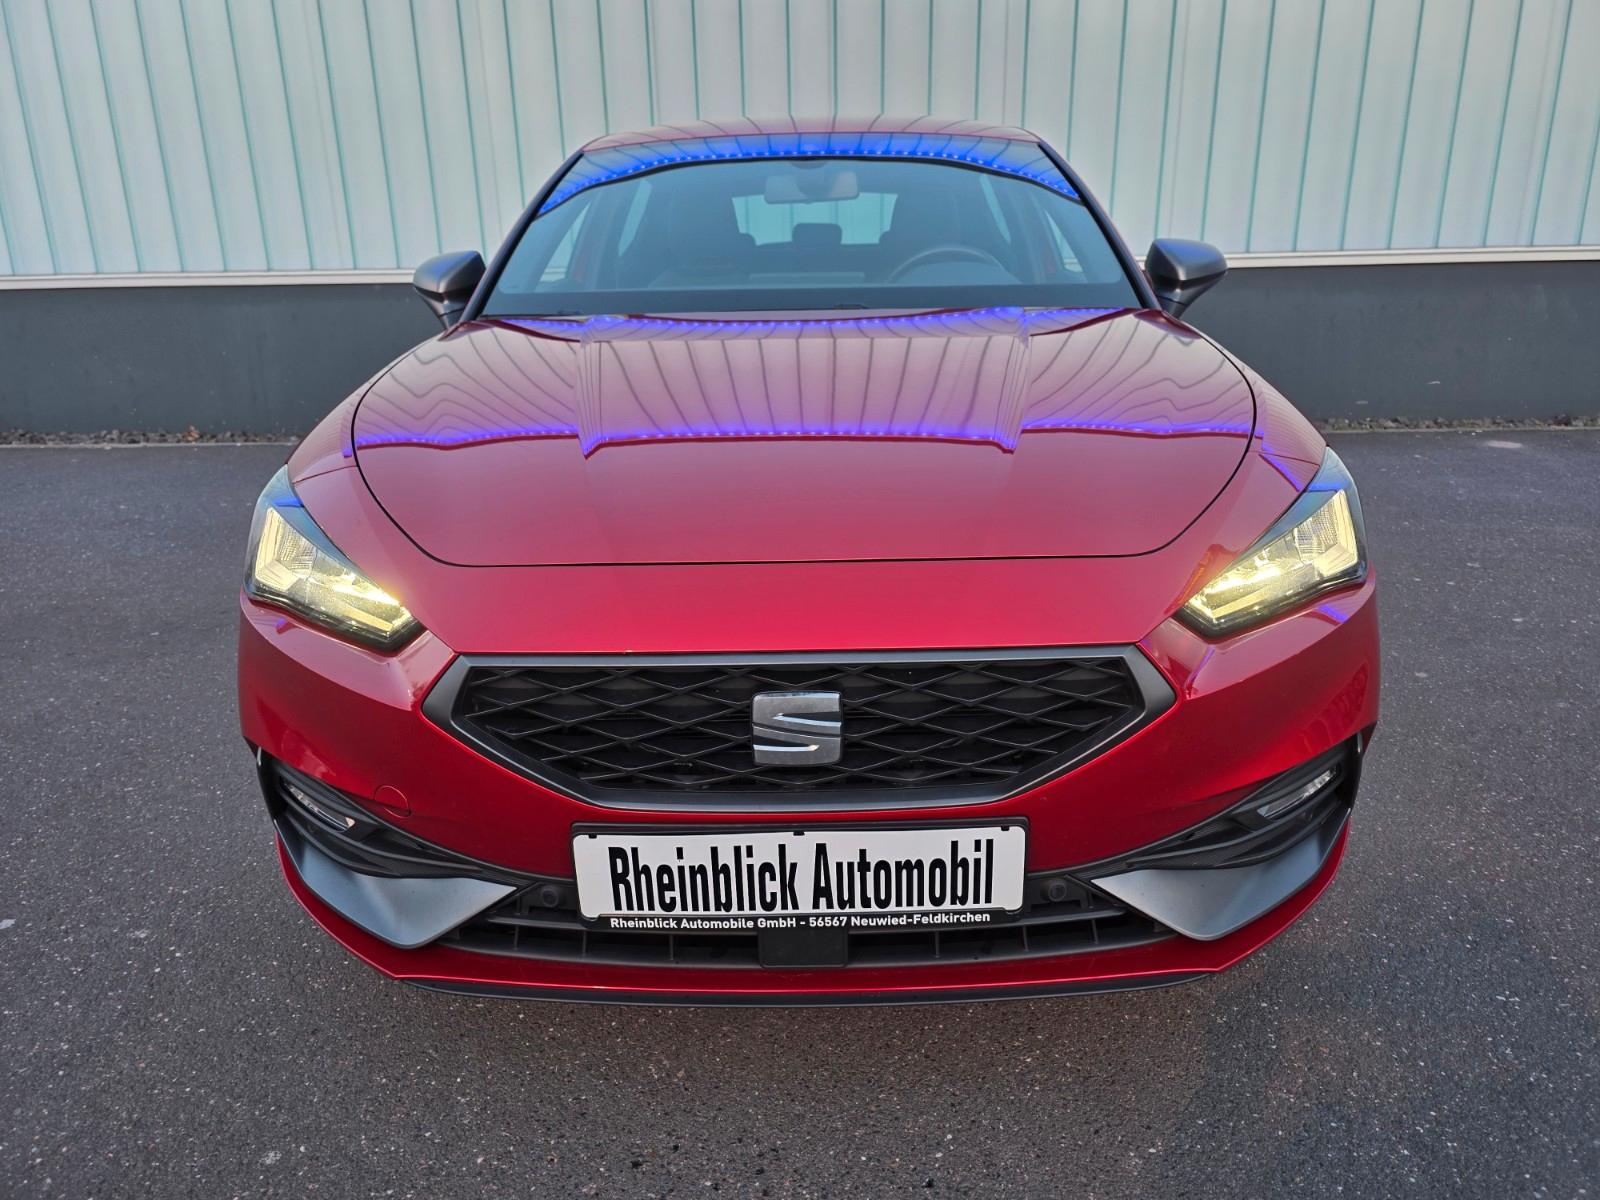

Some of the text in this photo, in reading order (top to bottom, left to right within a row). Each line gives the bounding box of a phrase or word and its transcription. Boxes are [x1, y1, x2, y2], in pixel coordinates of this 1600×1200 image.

[608, 839, 994, 913] Rheinblick Automobil
[610, 918, 678, 929] Rheinblick
[680, 919, 754, 929] Automobile
[757, 918, 796, 928] GmbH
[809, 917, 847, 927] 56567
[851, 912, 990, 926] Neuwied-Feldkirchen
